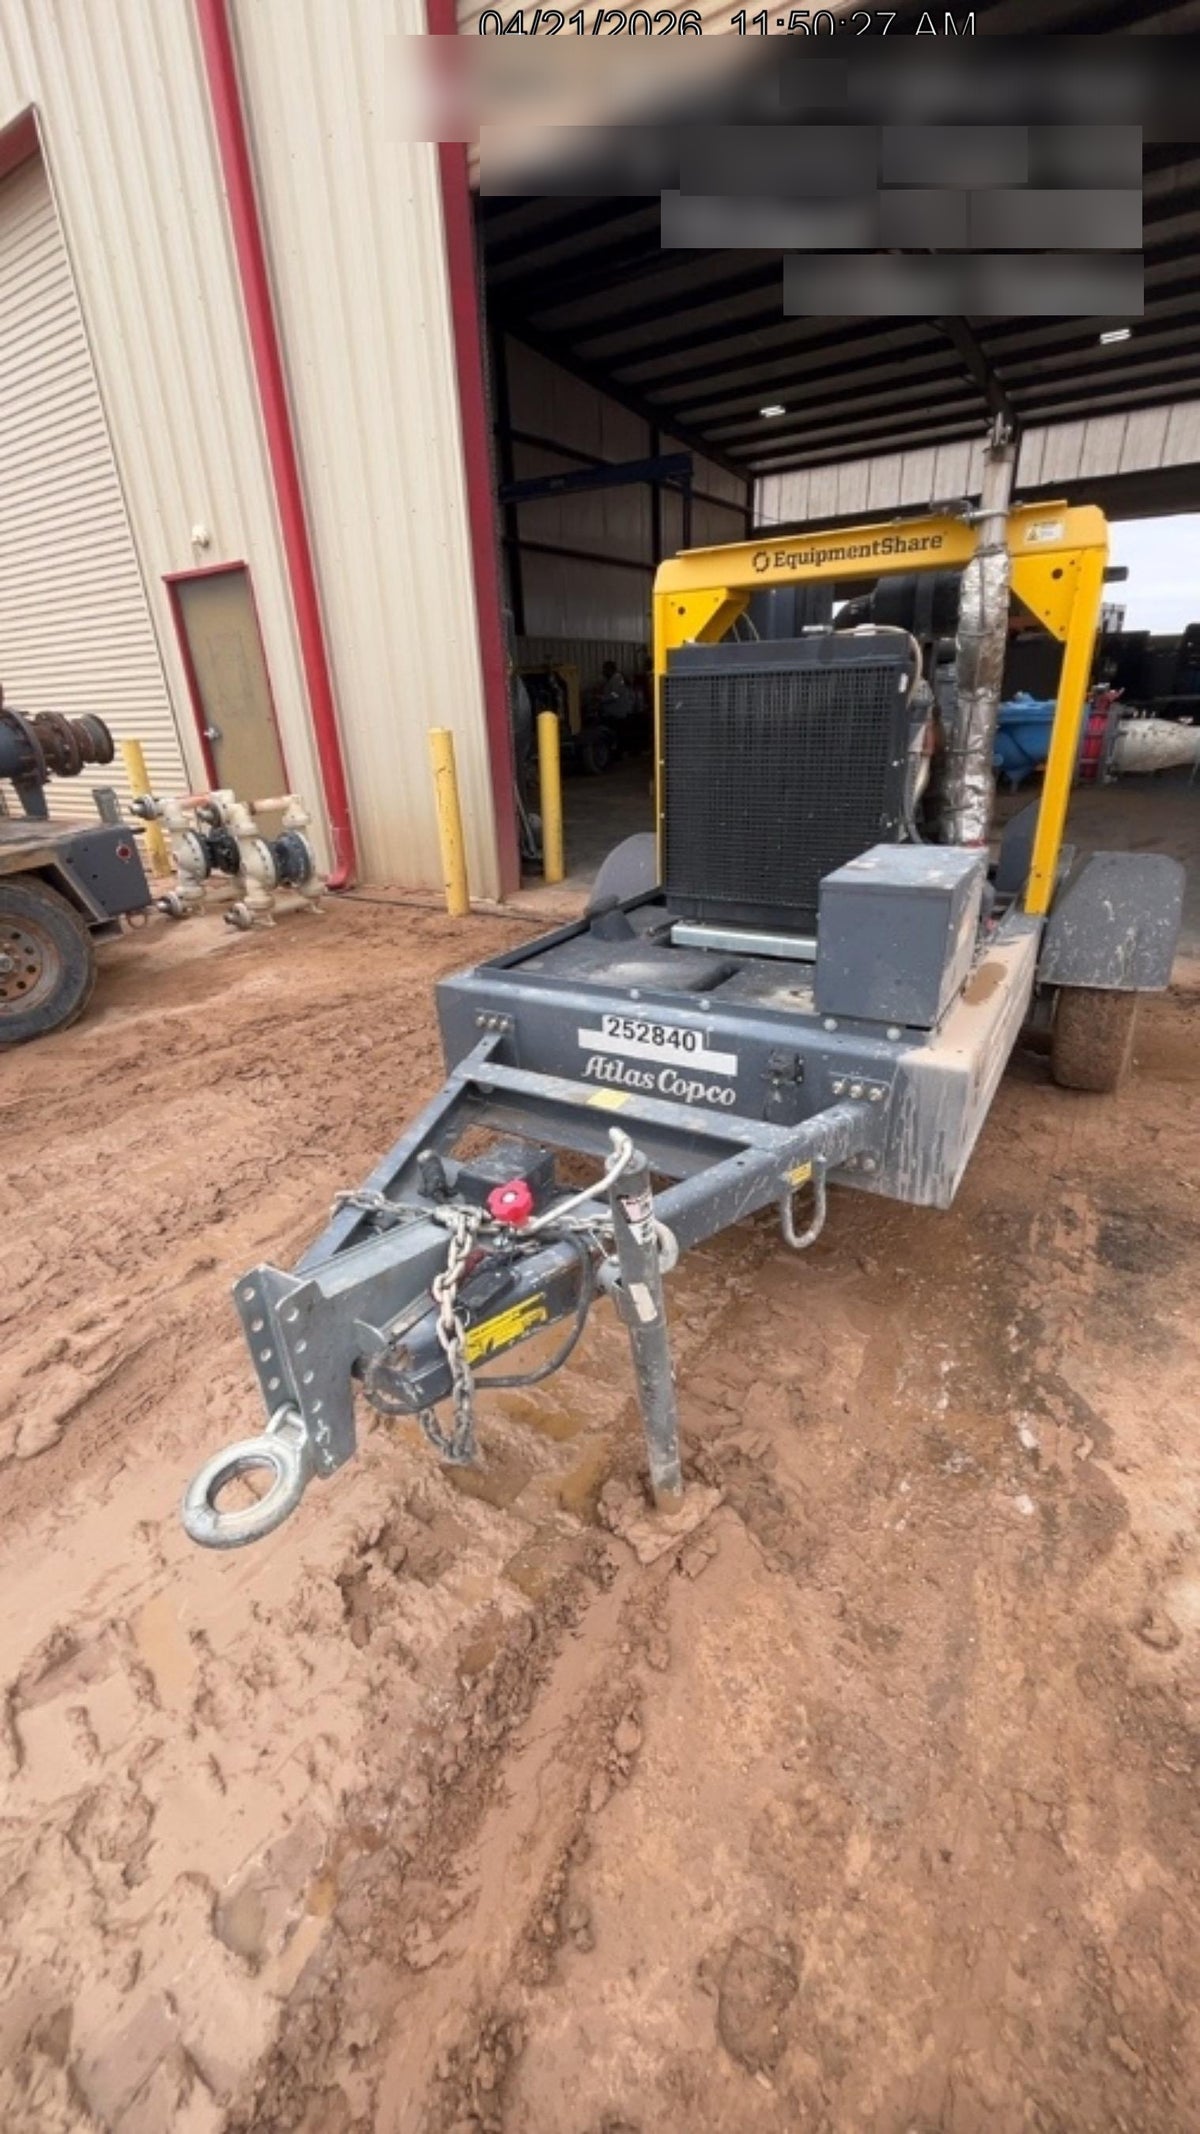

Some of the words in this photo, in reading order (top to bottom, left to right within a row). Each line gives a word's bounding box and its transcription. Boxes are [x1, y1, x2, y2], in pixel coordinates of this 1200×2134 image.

[773, 535, 942, 569] EquipmentShare
[608, 1017, 696, 1051] 252840
[581, 1055, 655, 1089] Atlas
[657, 1068, 736, 1106] Copco
